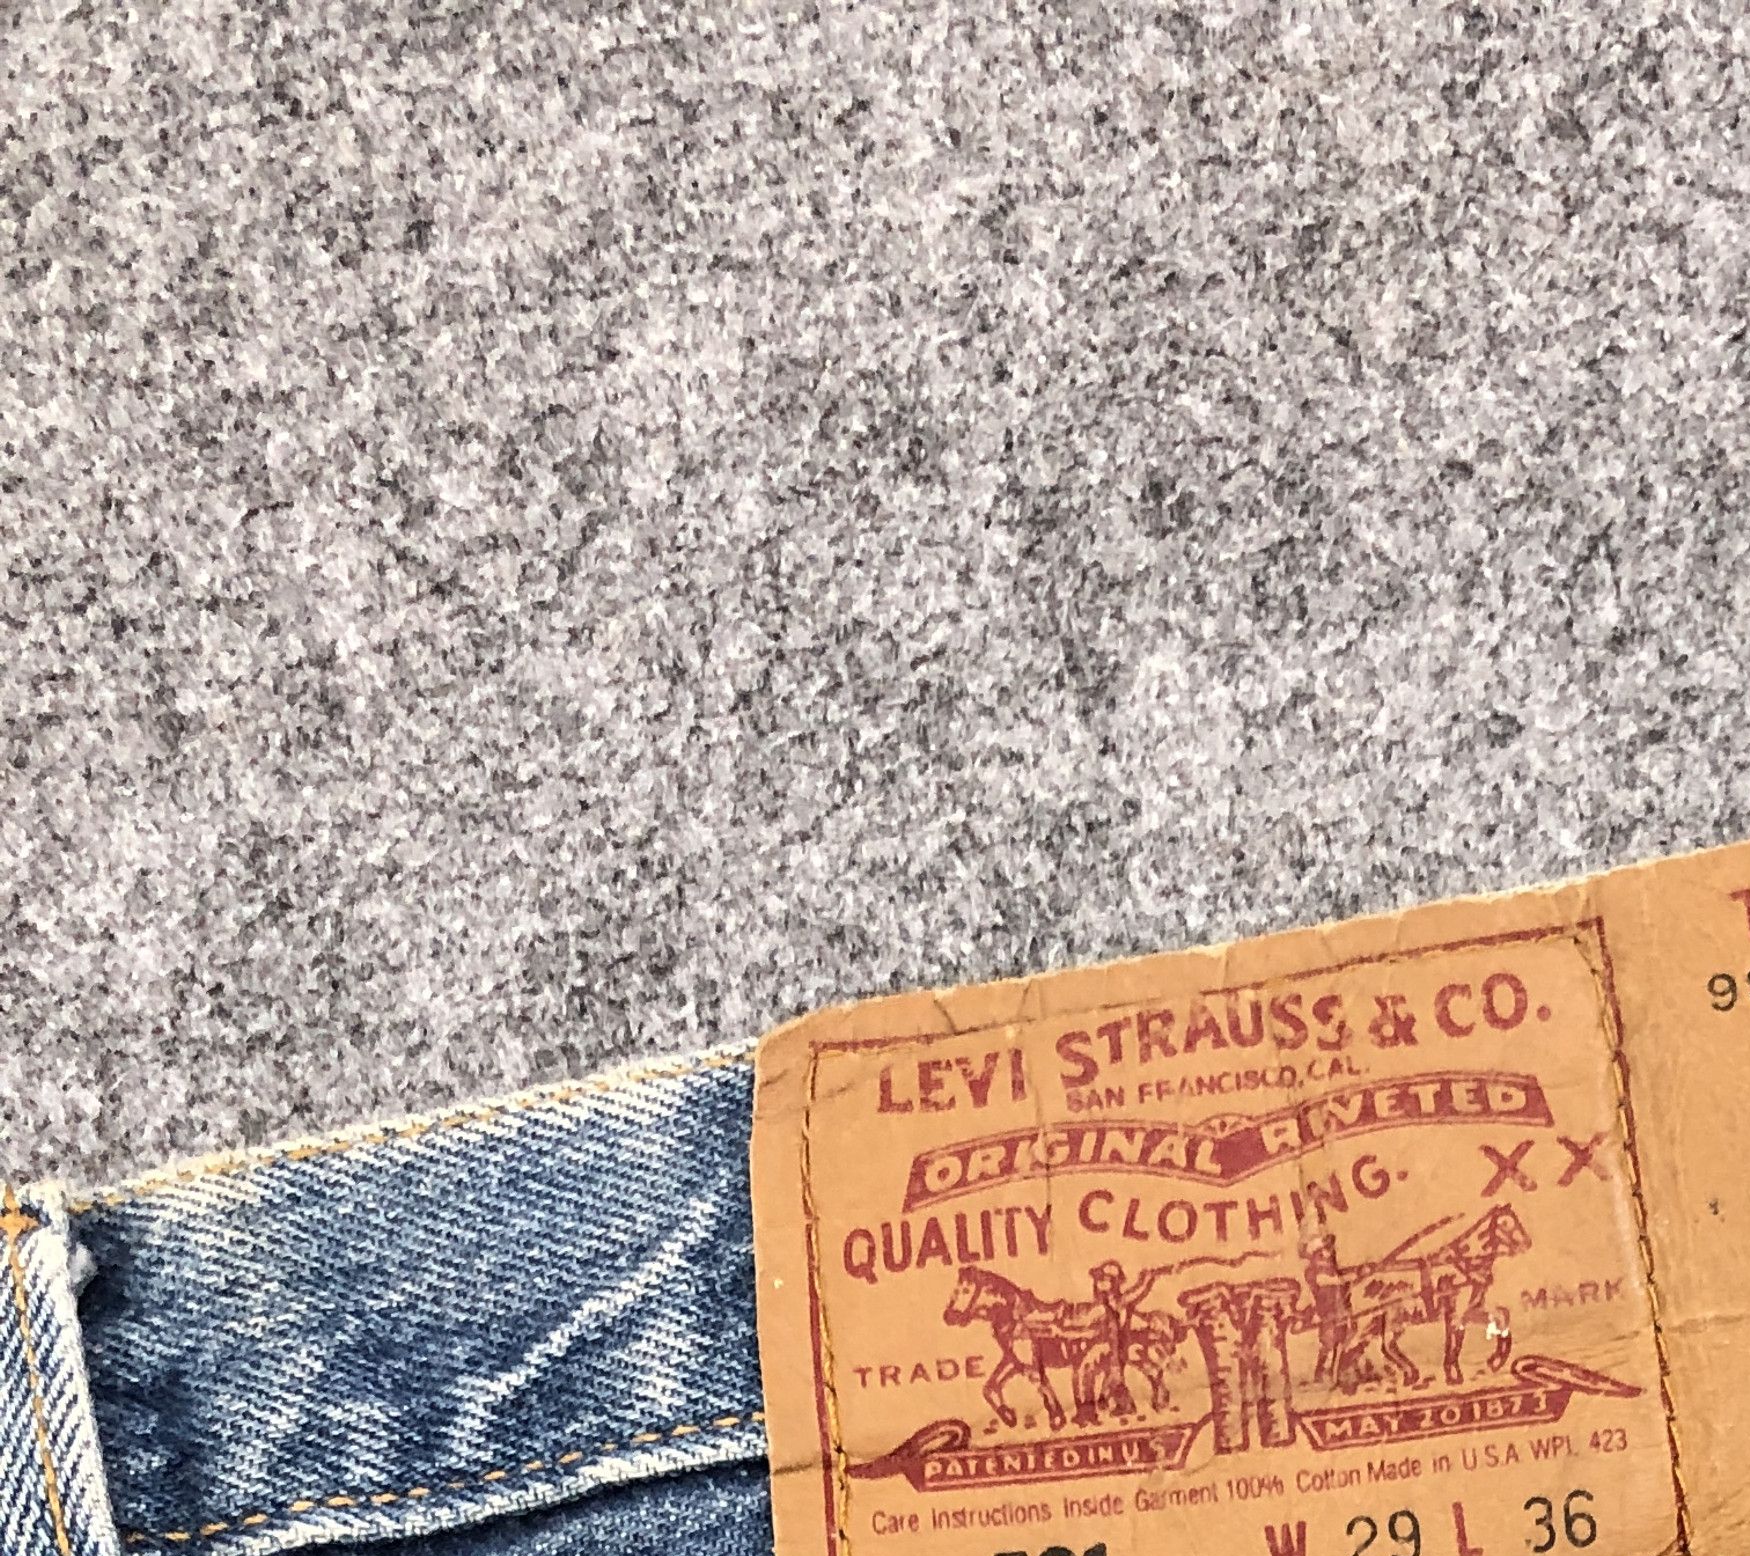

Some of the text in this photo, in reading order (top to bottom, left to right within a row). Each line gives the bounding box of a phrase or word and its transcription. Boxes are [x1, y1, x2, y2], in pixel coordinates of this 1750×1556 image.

[876, 972, 1552, 1114] LEVI STRAUSS & CO.
[1065, 1086, 1125, 1113] SAN
[924, 1081, 1527, 1193] ORIGINAL RIVETED
[842, 1203, 1052, 1286] QUALITY
[1521, 1278, 1627, 1310] MARK
[852, 1355, 987, 1389] TRADE
[1325, 1411, 1402, 1440] MAY
[1472, 1388, 1548, 1422] 1873
[872, 1508, 920, 1536] Care
[932, 1499, 1051, 1530] Instructions
[1064, 1493, 1124, 1520] Inside
[1135, 1488, 1219, 1513] Garment
[1226, 1475, 1285, 1501] 100%
[1296, 1467, 1362, 1494] Cotton
[1366, 1456, 1423, 1484] Made
[1433, 1454, 1451, 1473] in
[1588, 1427, 1628, 1454] 423
[1522, 1488, 1598, 1555] 36
